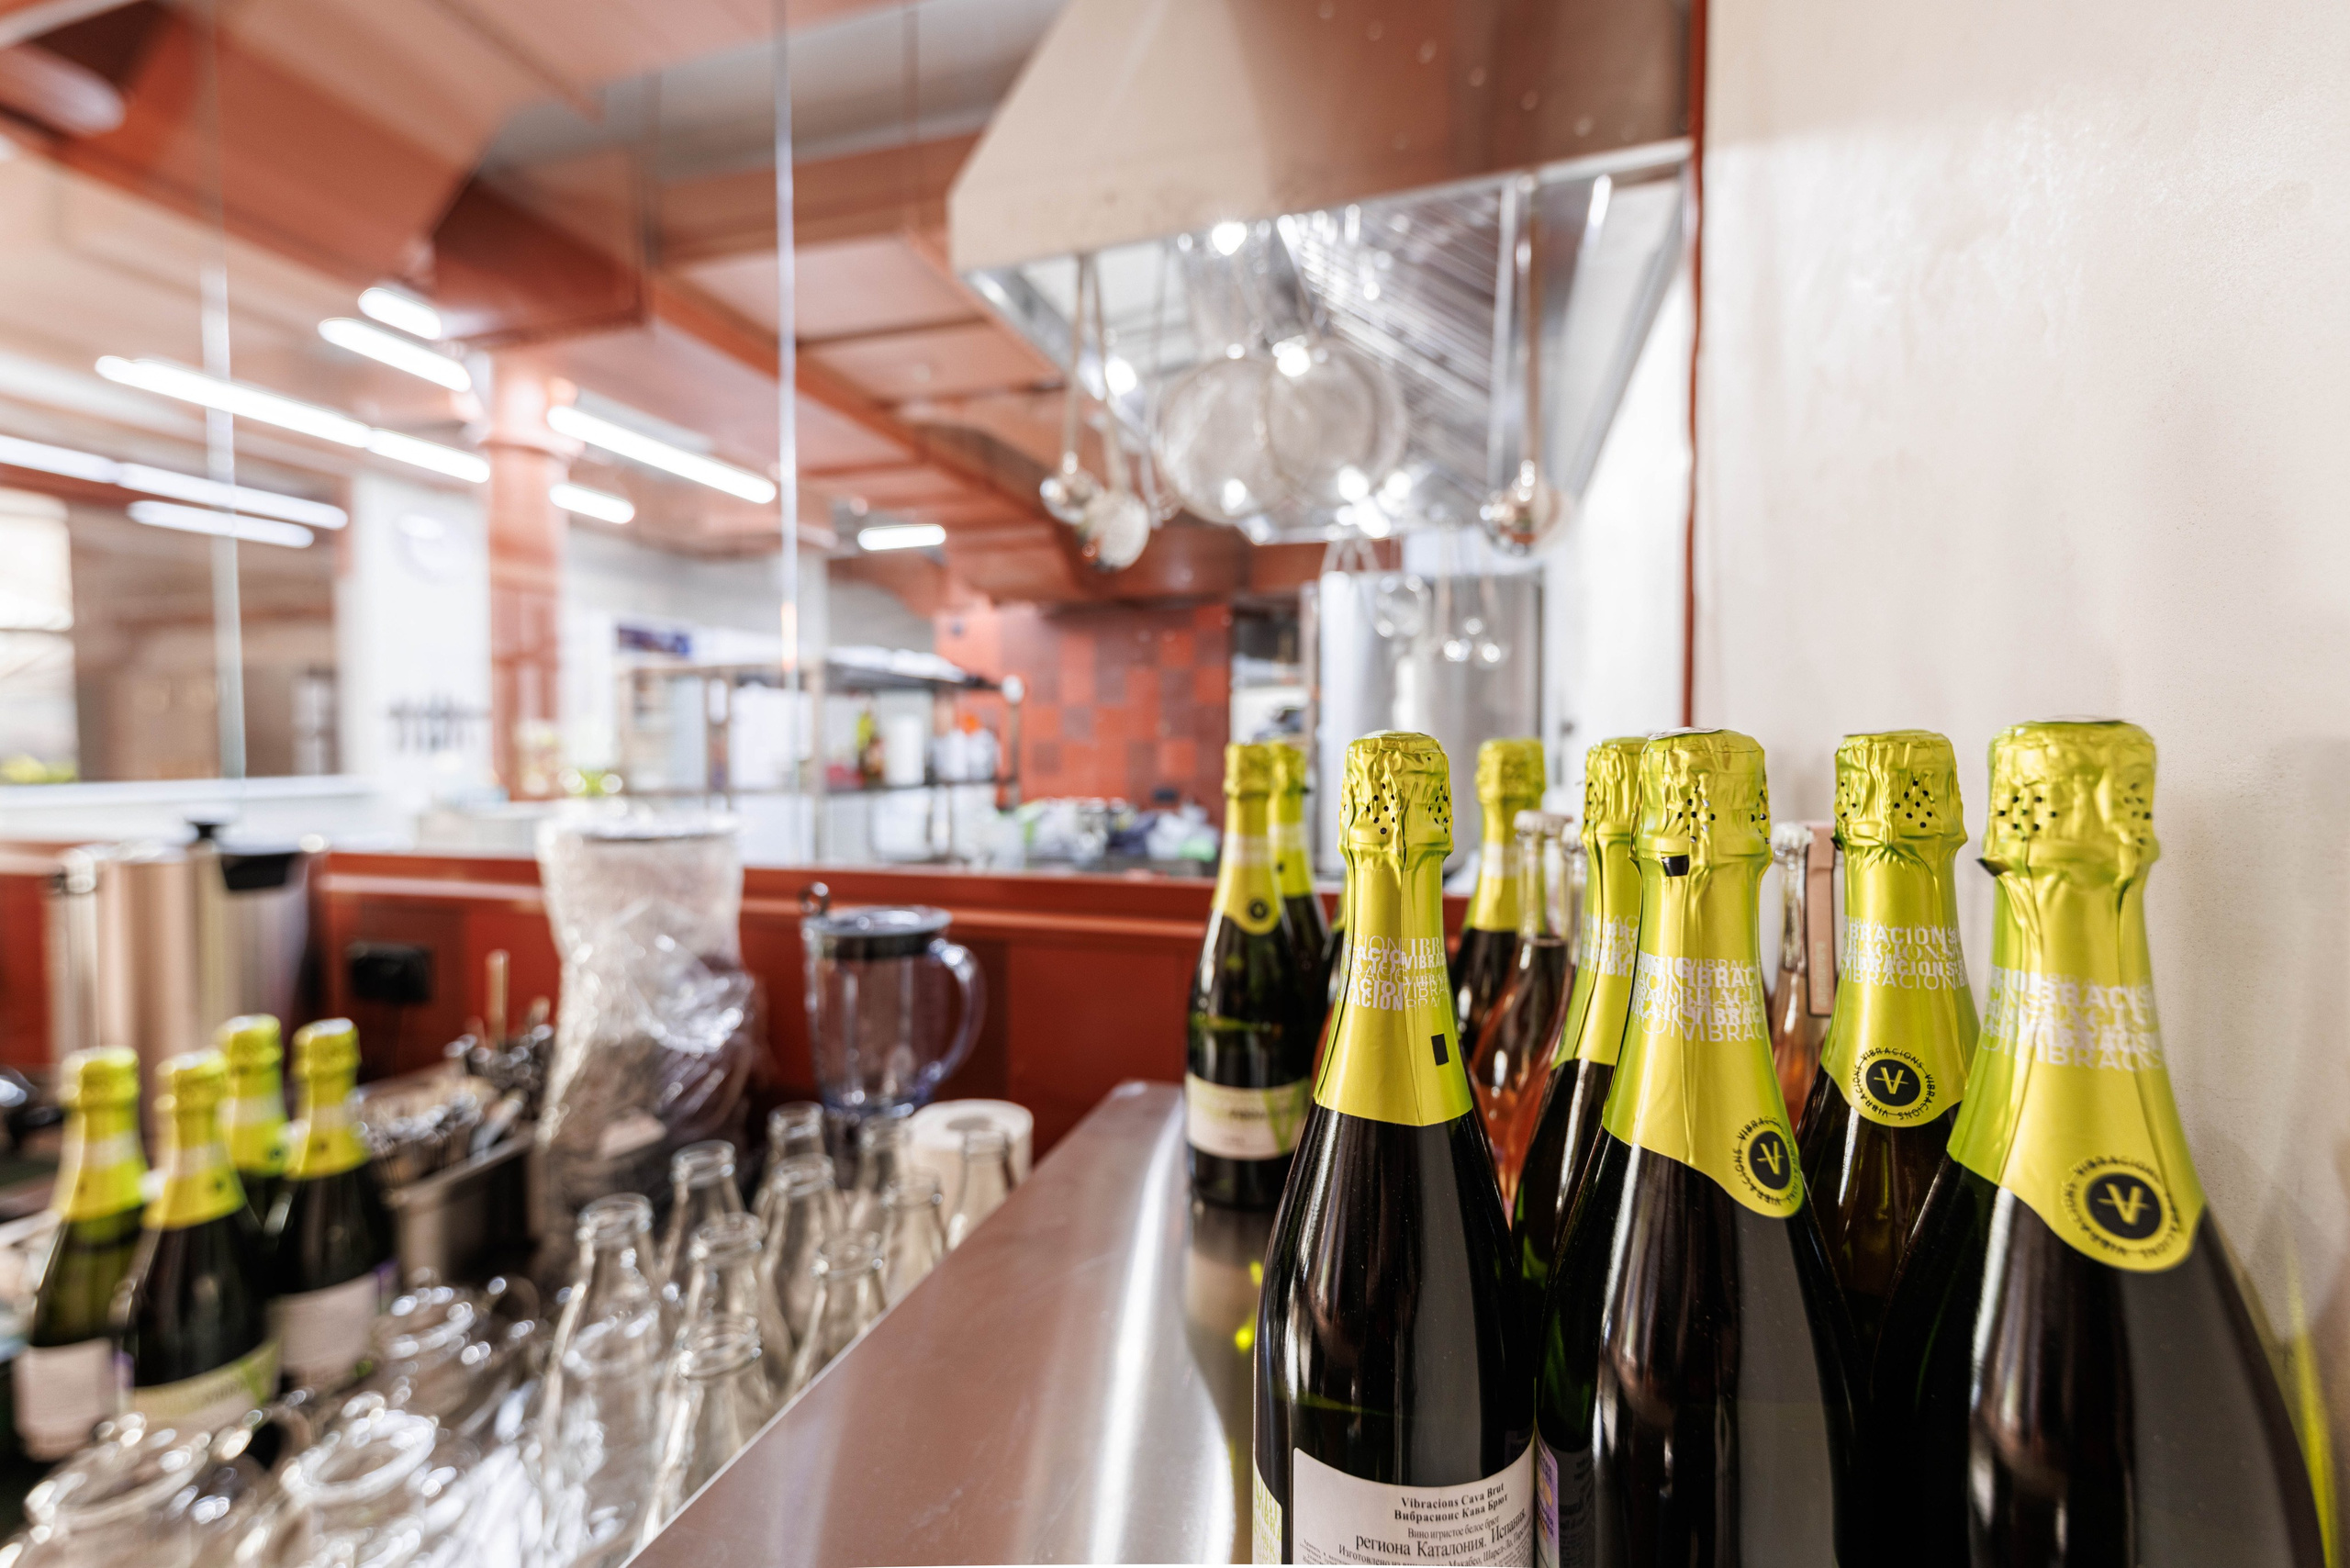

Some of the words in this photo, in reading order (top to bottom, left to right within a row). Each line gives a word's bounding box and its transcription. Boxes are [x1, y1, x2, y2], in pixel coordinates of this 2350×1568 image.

[1393, 1508, 1460, 1524] Вибрасионс
[1461, 1503, 1486, 1519] Кава
[1488, 1494, 1508, 1512] Брют
[1401, 1495, 1459, 1510] Vibracions
[1461, 1491, 1485, 1506] Cava
[1487, 1482, 1505, 1498] Brut
[1407, 1527, 1428, 1539] Вино
[1429, 1527, 1464, 1540] игристое
[1464, 1522, 1484, 1534] белое
[1484, 1516, 1500, 1529] брют
[1356, 1534, 1411, 1556] региона
[1416, 1537, 1487, 1558] Каталония.
